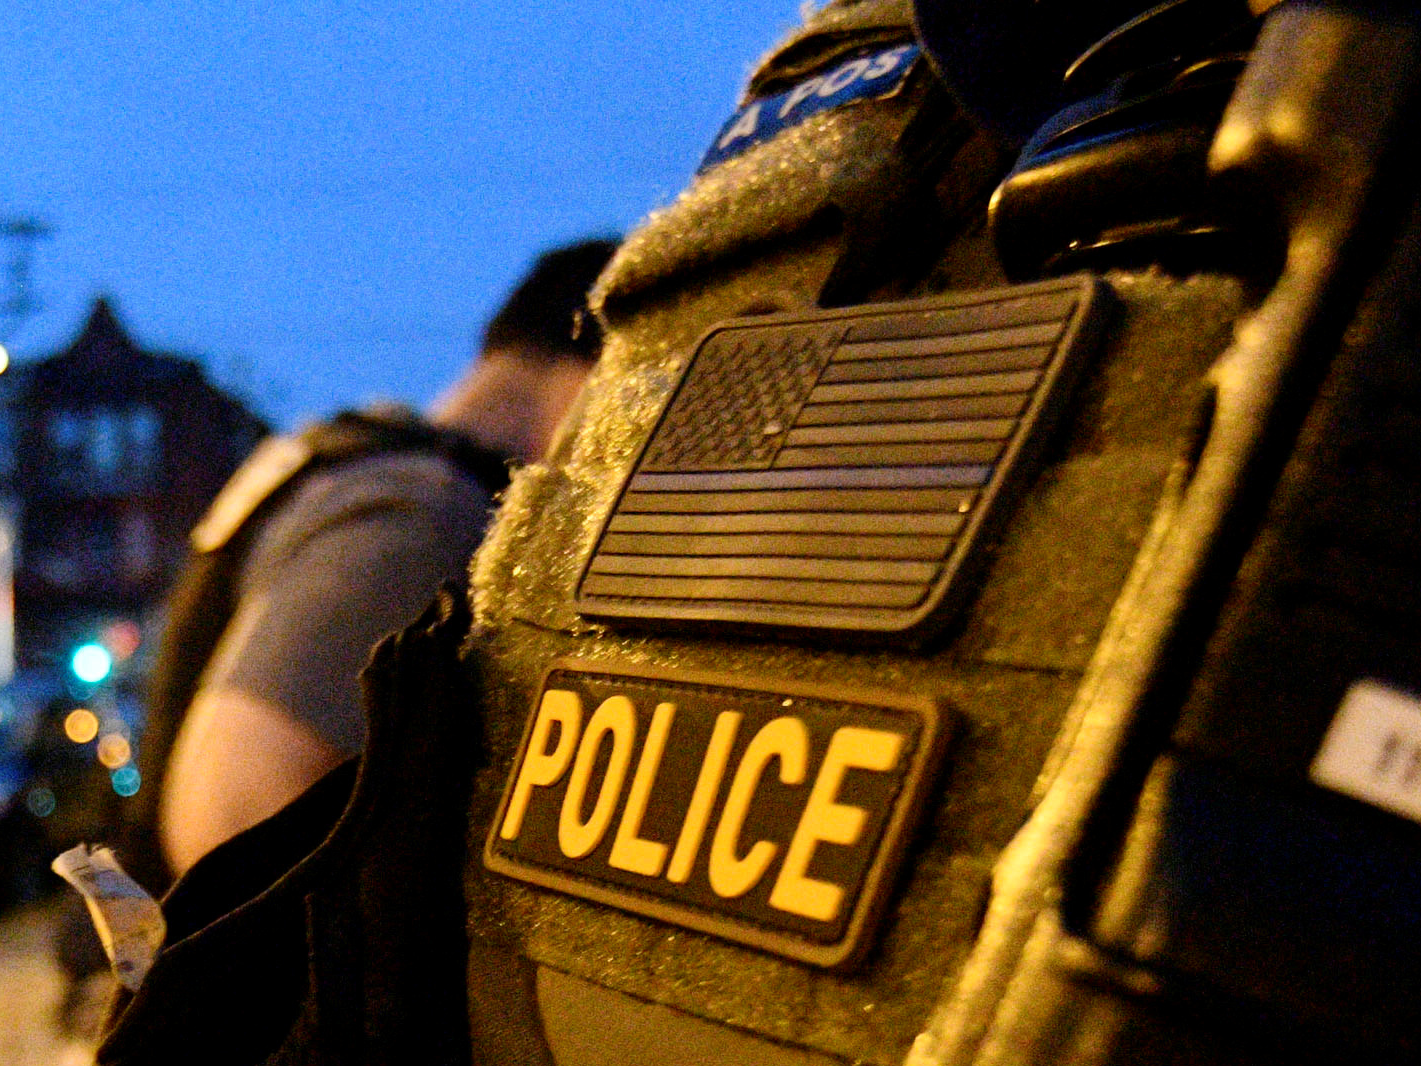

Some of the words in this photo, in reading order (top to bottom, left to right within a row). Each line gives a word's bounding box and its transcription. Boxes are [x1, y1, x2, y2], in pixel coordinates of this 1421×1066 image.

[718, 101, 761, 150] A
[778, 44, 912, 119] POS
[500, 689, 904, 922] POLICE
